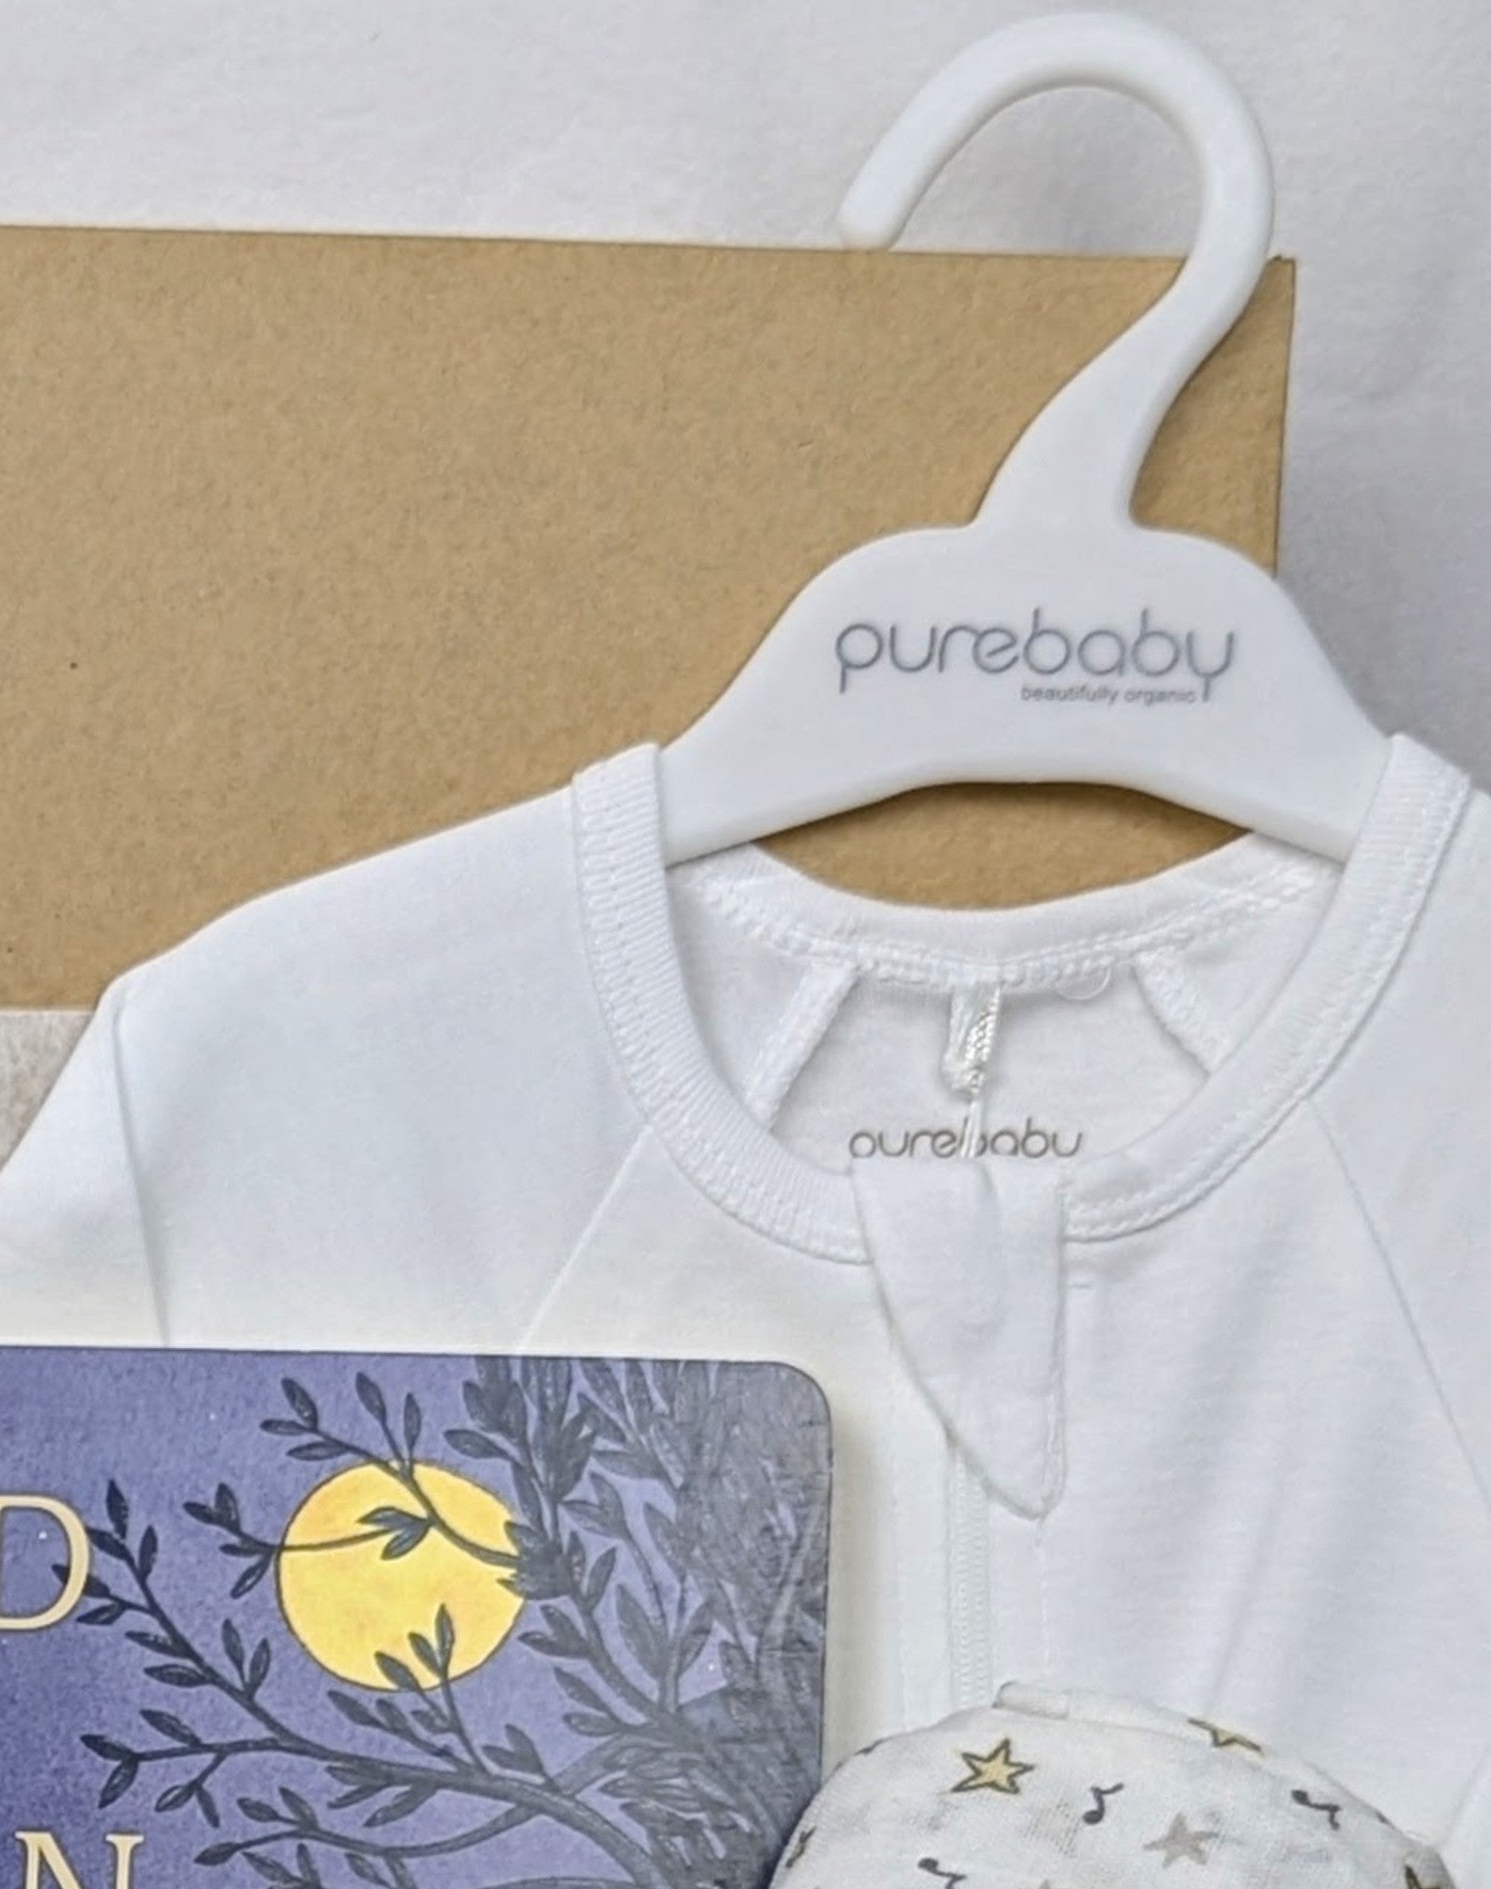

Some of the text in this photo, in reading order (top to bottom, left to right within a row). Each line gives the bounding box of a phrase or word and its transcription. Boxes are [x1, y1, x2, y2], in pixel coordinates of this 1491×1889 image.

[836, 608, 1235, 702] purebaby
[1021, 685, 1194, 705] beautifully organic
